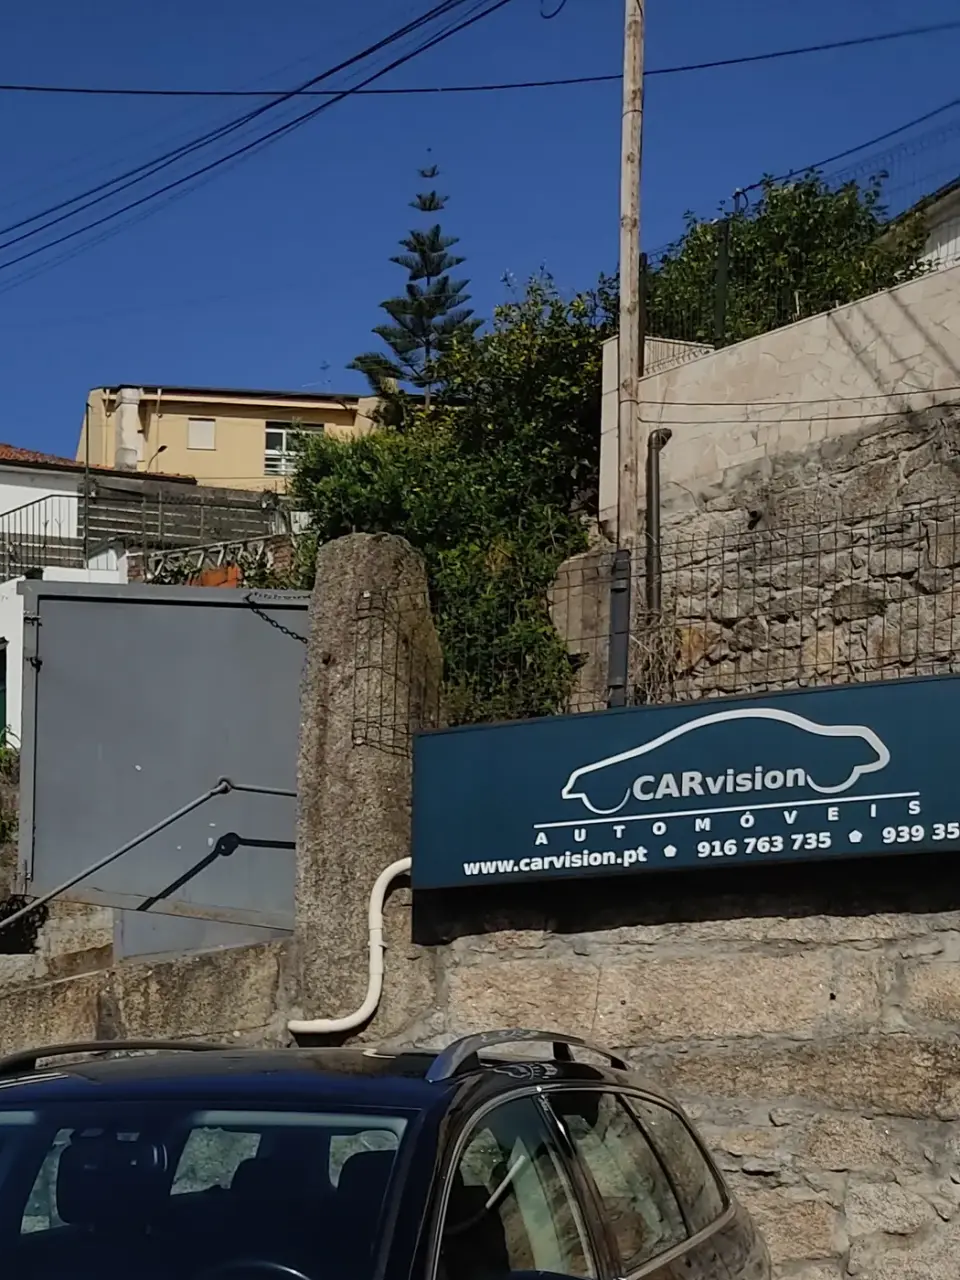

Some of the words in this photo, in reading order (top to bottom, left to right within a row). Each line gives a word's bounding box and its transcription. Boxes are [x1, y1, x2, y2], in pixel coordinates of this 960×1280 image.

[632, 766, 806, 801] CARvision
[534, 800, 921, 846] AUTOMÓVEIS
[463, 846, 648, 876] www.carvision.pt
[696, 840, 738, 858] 916
[744, 836, 784, 854] 763
[791, 832, 832, 850] 735
[882, 825, 925, 843] 939
